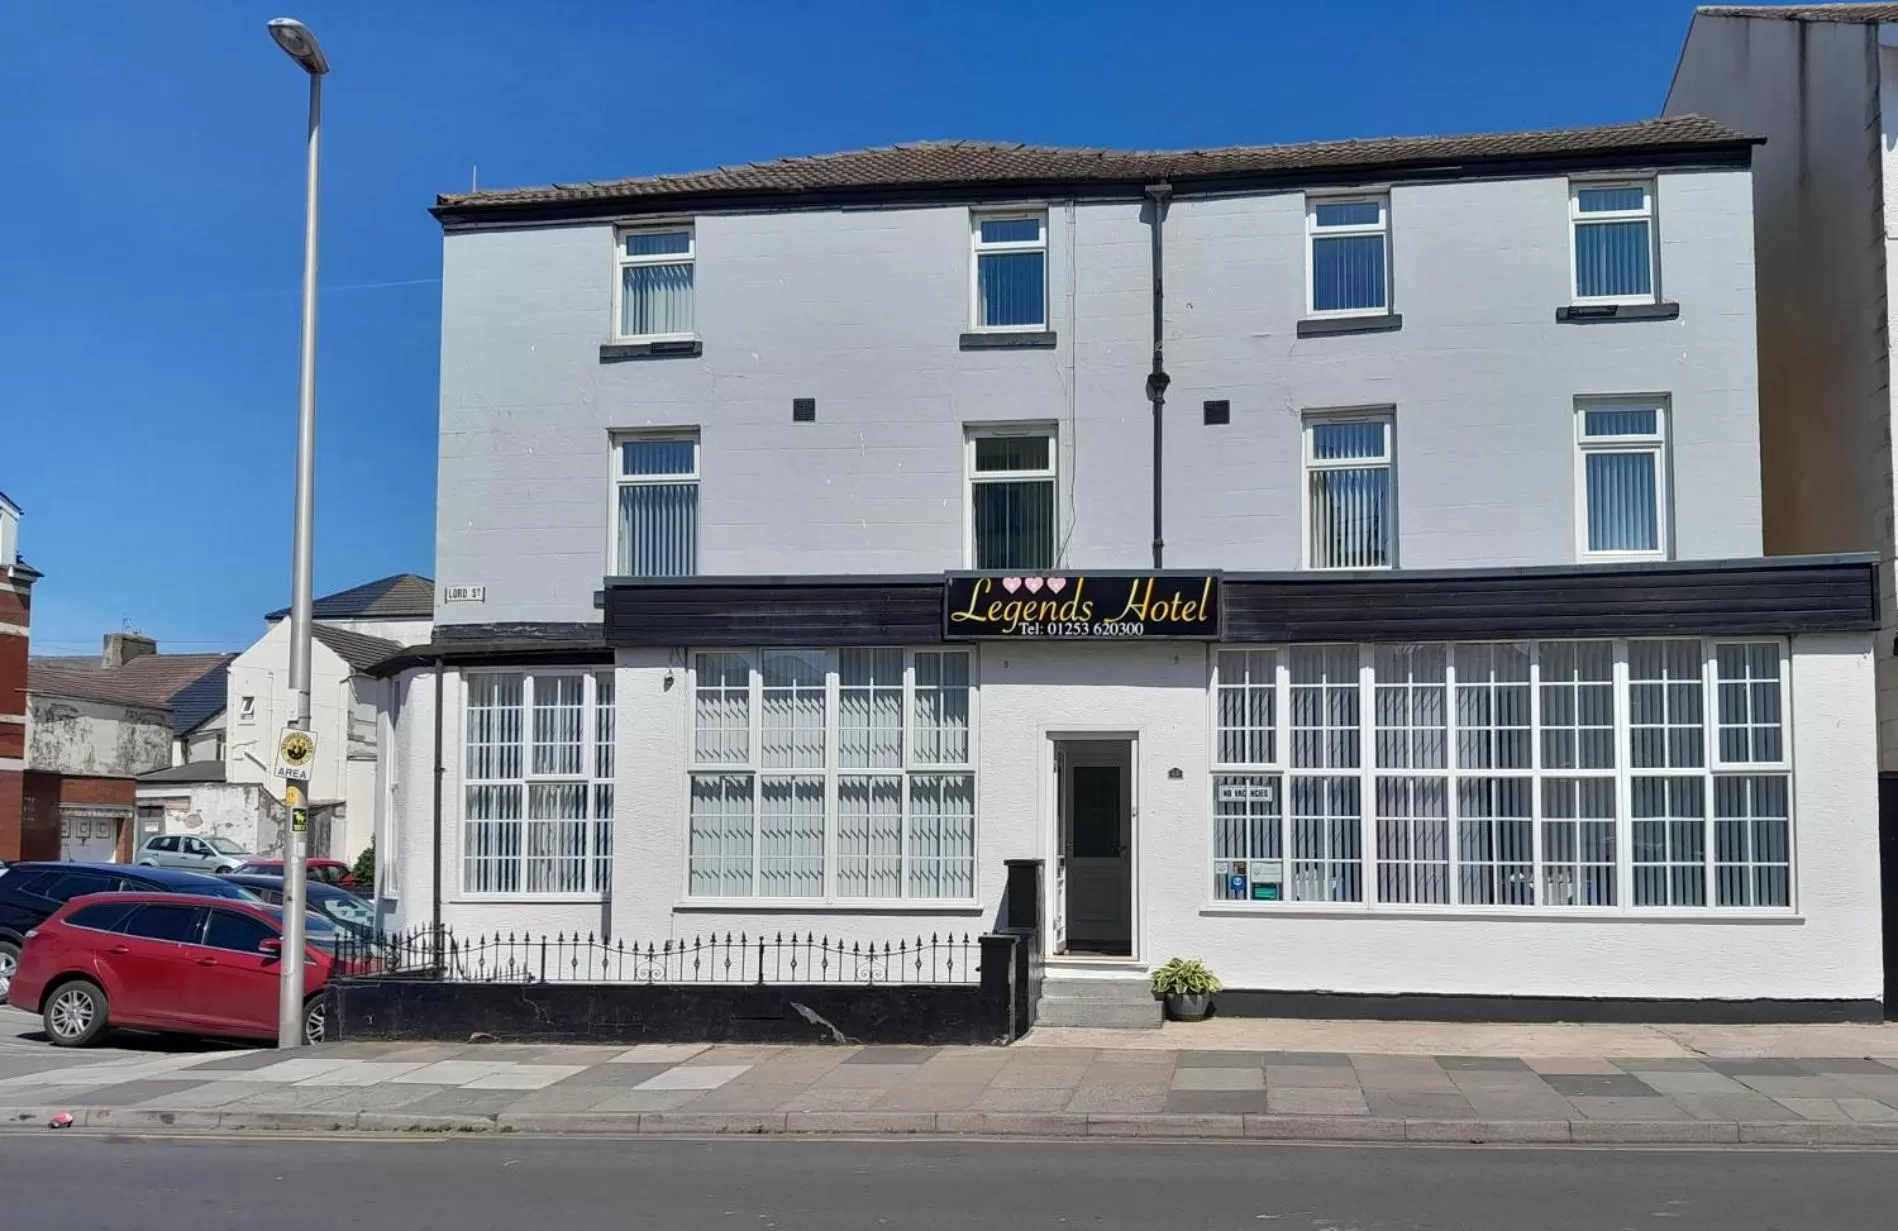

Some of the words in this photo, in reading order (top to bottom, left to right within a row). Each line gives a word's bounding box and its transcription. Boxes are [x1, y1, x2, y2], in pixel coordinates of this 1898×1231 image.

[448, 588, 468, 599] LORD
[951, 576, 1093, 633] Legends
[1104, 576, 1212, 623] Hotel
[1019, 622, 1044, 635] Tel:
[1047, 622, 1089, 635] 01253
[1093, 622, 1144, 636] 620300
[278, 767, 307, 780] AREA
[1223, 789, 1232, 798] NO
[1234, 789, 1269, 798] VACNCIES
